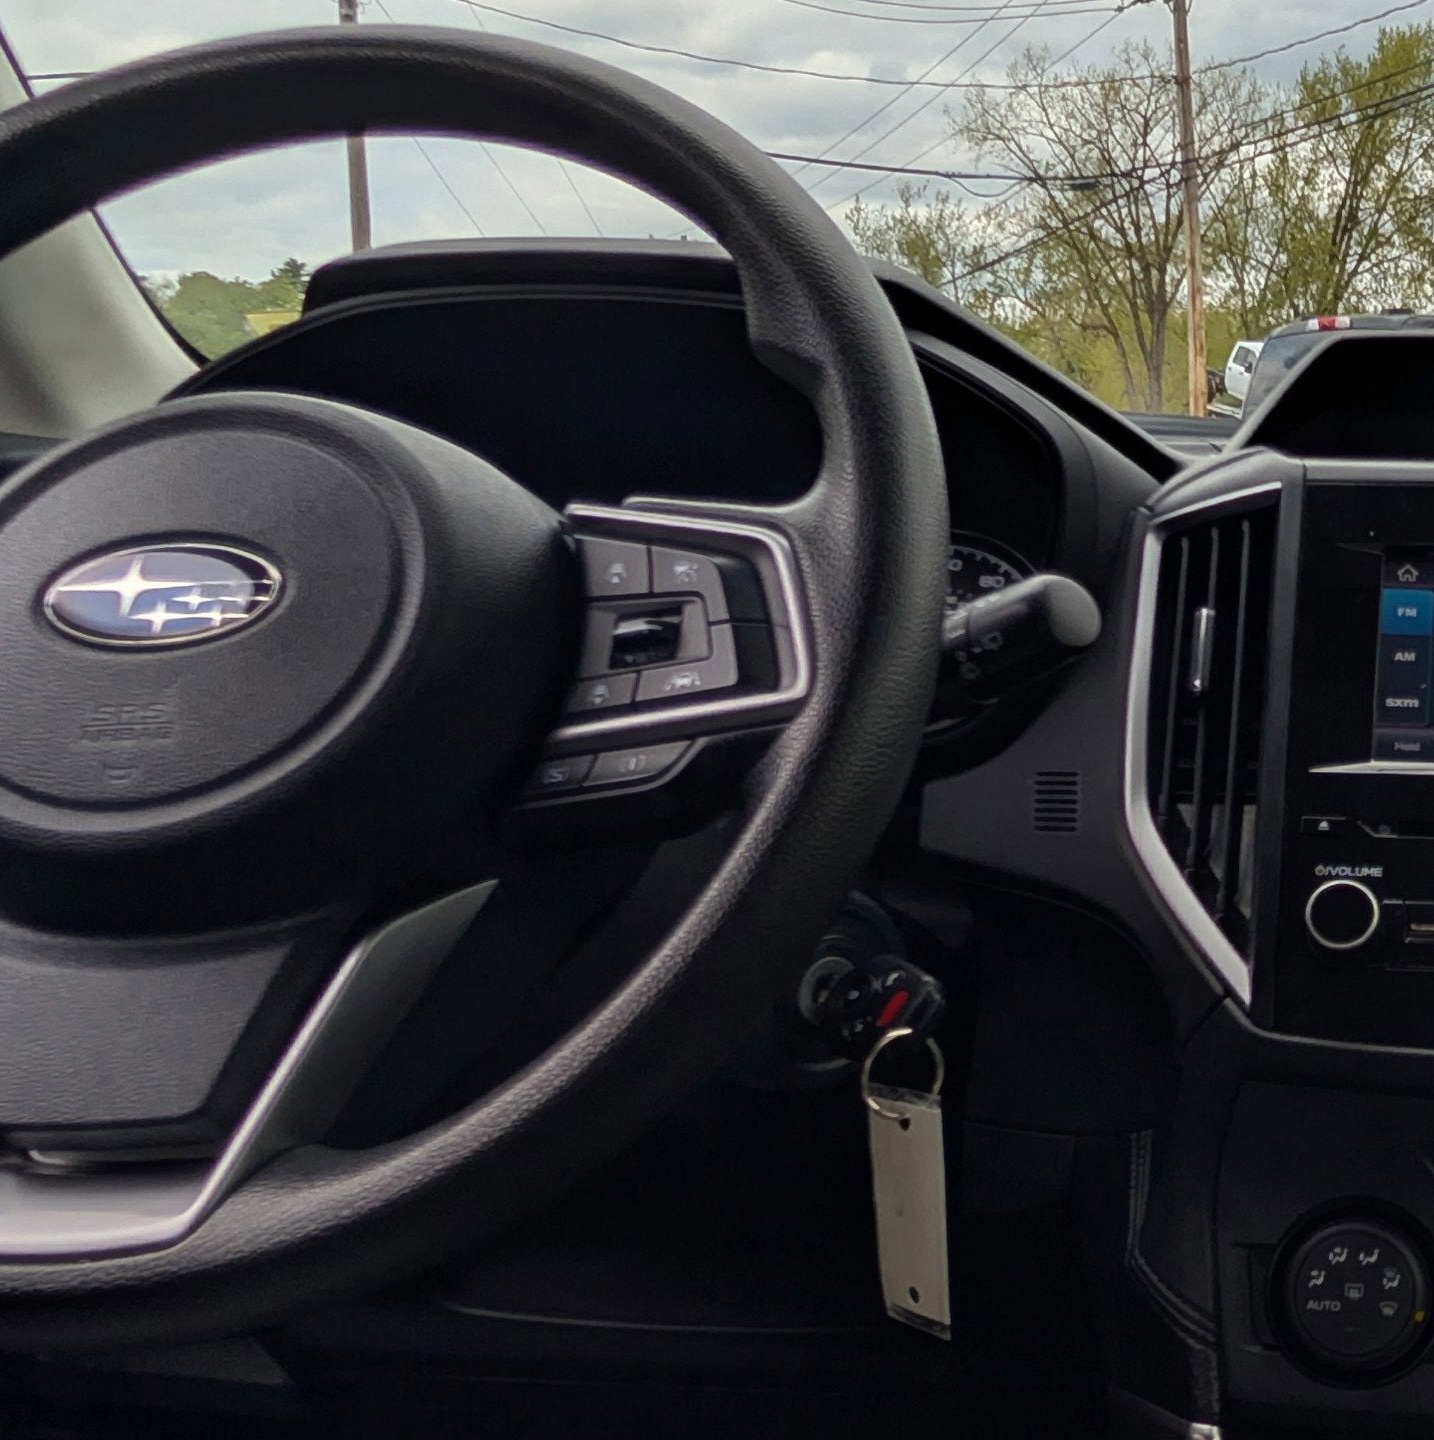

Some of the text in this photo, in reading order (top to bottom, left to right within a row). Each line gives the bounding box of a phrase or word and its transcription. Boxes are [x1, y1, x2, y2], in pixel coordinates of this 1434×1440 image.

[1397, 607, 1417, 618] FM
[1394, 652, 1416, 662] AM
[1307, 1300, 1341, 1312] AUTO
